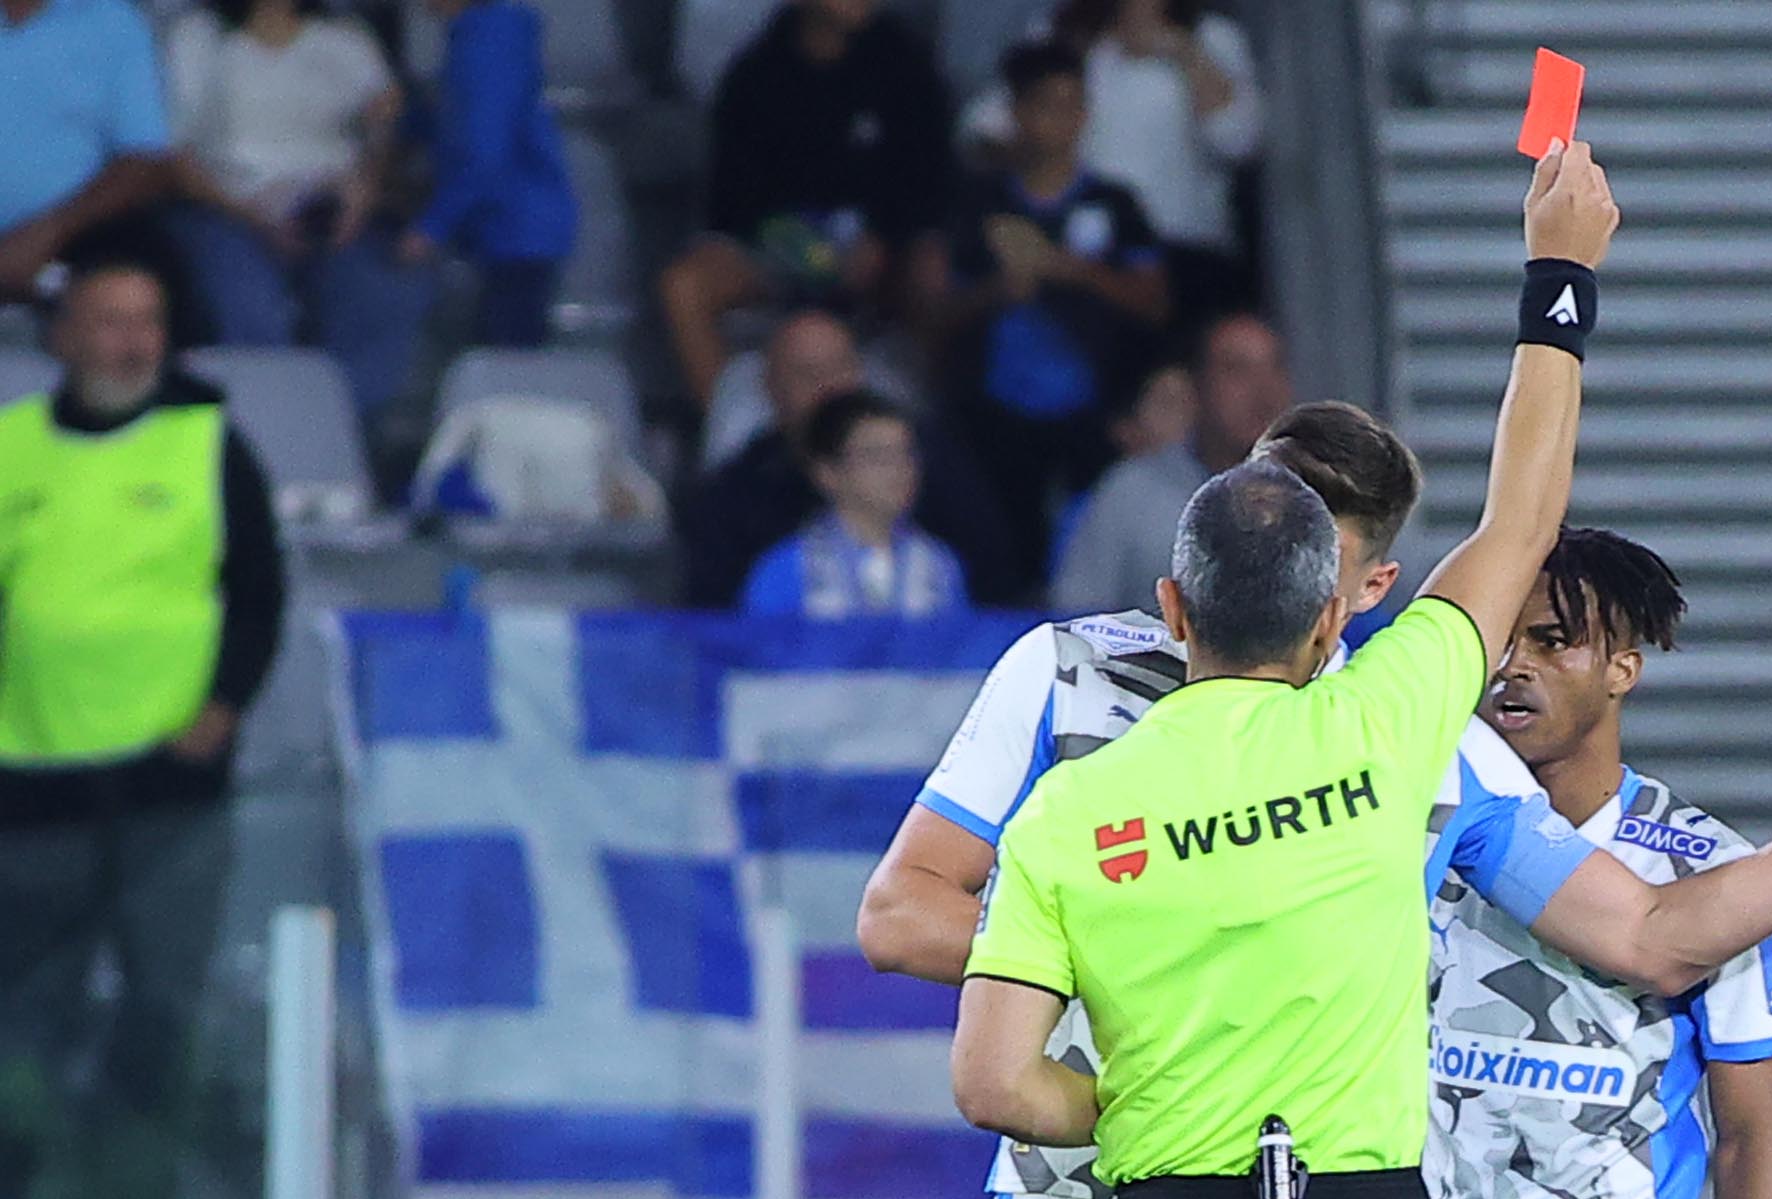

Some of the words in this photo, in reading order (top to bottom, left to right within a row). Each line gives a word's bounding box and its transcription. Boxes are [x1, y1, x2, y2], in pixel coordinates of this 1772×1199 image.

[1081, 623, 1156, 643] PETROLINA
[1617, 819, 1711, 856] DIMCO
[1429, 1024, 1625, 1097] toiximan
